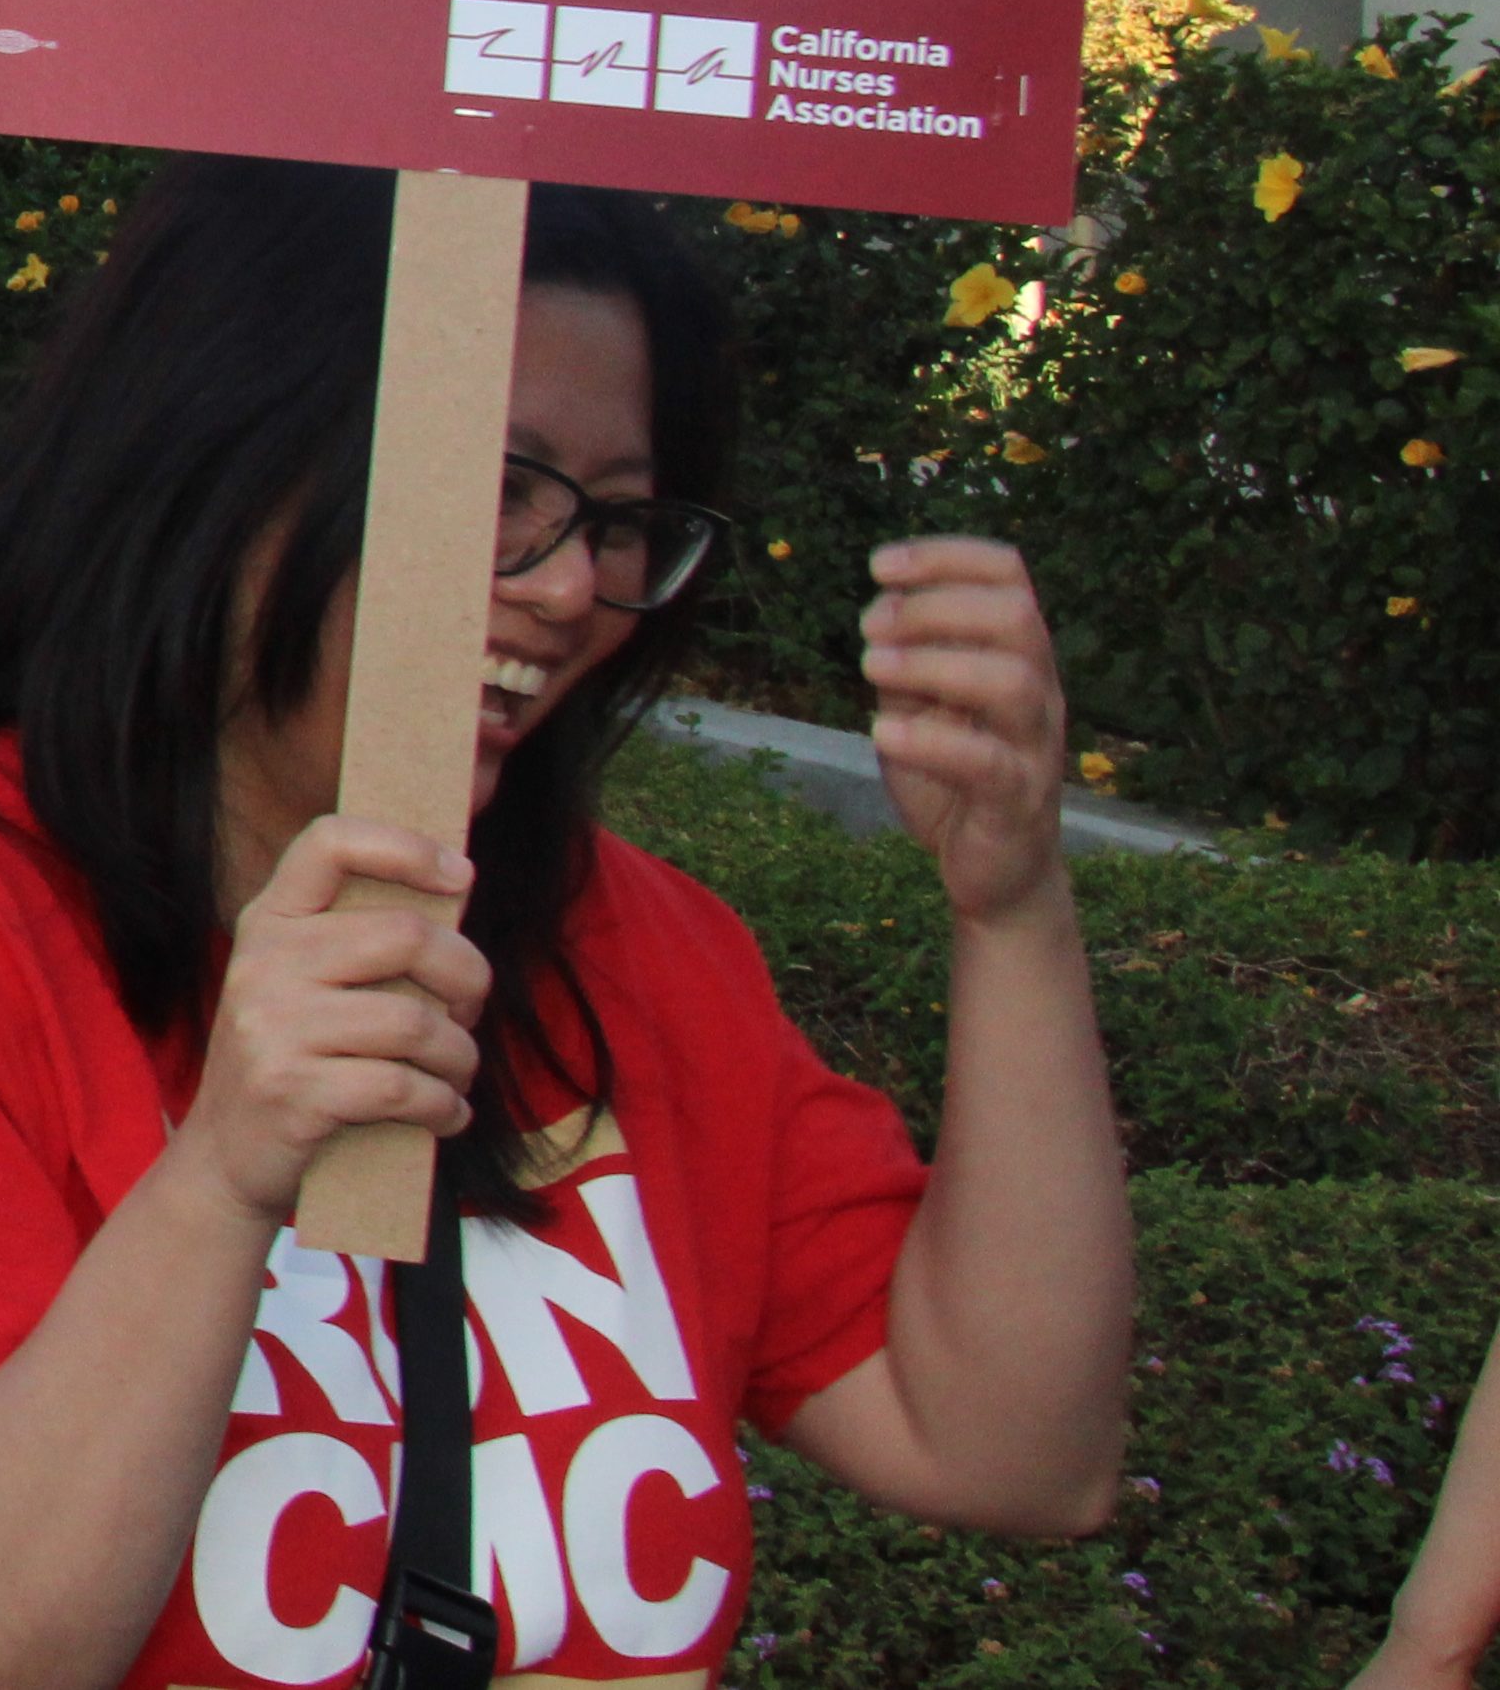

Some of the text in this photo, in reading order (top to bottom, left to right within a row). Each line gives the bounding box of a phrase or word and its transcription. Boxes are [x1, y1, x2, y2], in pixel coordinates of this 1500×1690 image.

[770, 25, 952, 70] California
[769, 60, 898, 100] Nurses
[764, 93, 984, 141] Association
